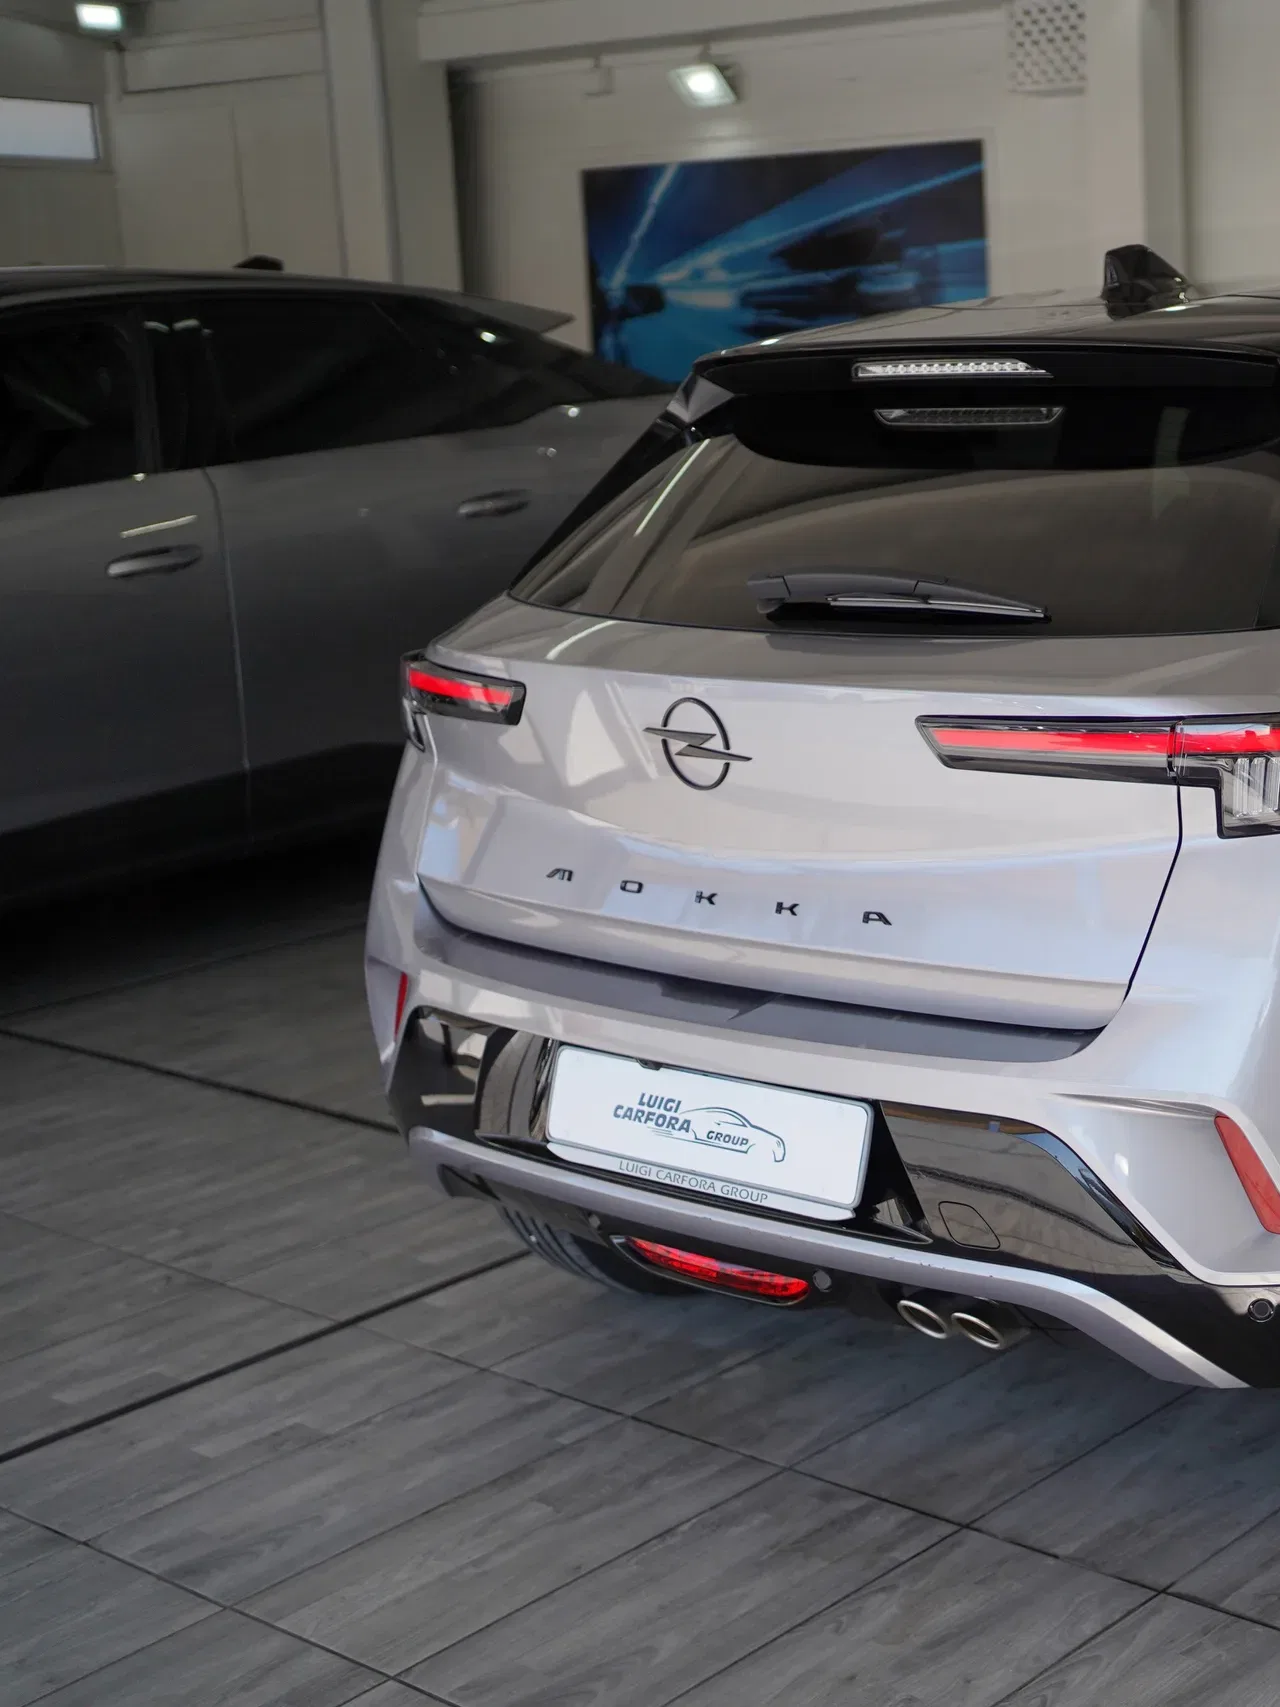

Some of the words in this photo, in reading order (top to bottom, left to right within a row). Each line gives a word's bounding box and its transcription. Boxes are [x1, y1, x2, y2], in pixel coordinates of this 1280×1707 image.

[546, 867, 892, 925] MOKKA
[638, 1092, 682, 1113] LUIGI
[613, 1105, 692, 1133] CARFORA
[706, 1130, 749, 1147] GROUP
[619, 1160, 651, 1177] LUIGI
[656, 1169, 716, 1192] CARFORA
[721, 1184, 768, 1204] GROUP
